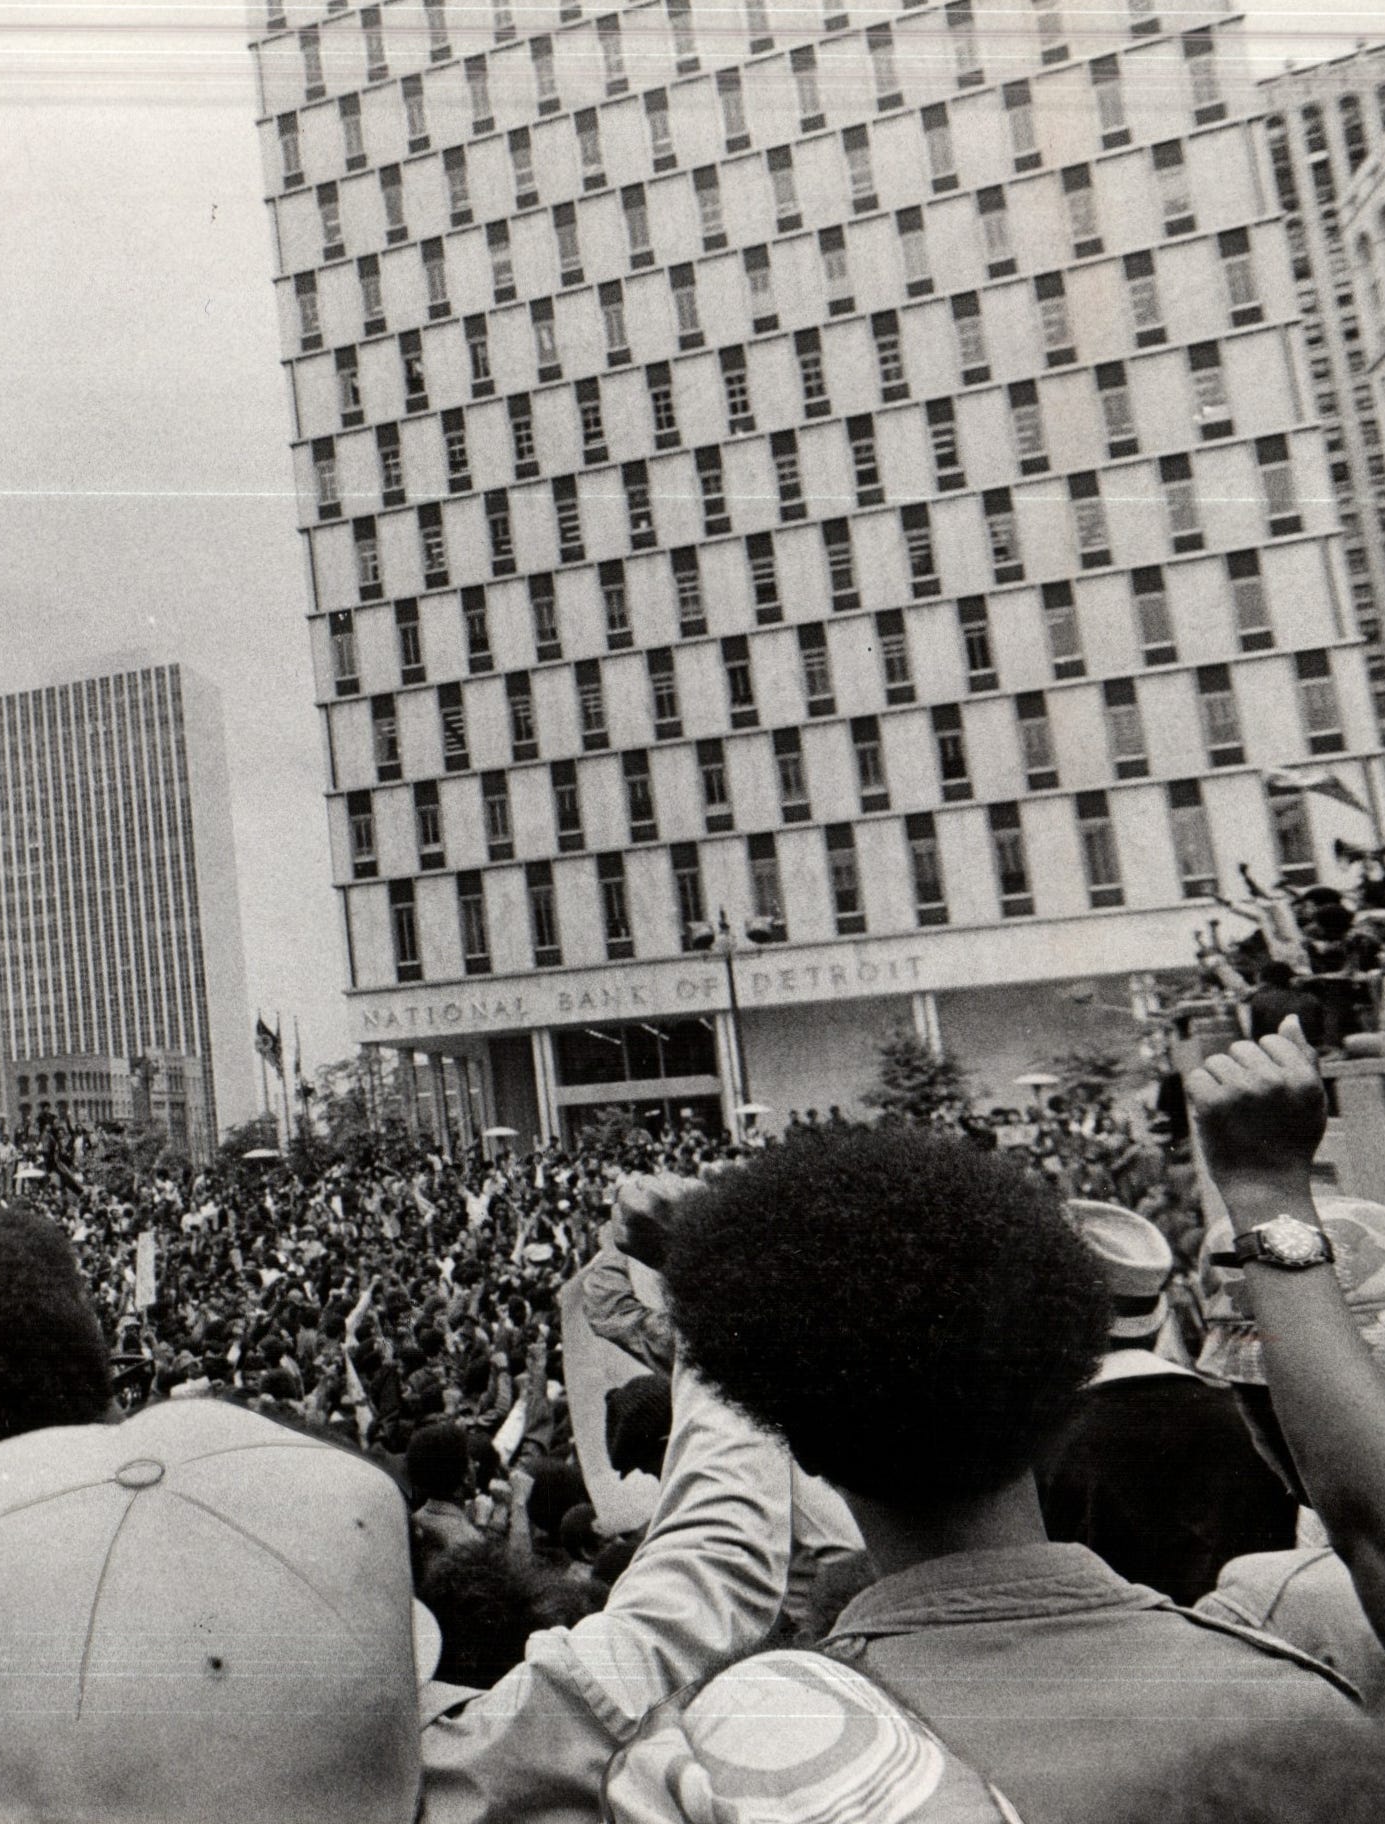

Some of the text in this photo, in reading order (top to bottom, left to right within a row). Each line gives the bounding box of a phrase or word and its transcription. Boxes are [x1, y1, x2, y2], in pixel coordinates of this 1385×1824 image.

[364, 956, 925, 1030] NATIONAL BANK OF DETROIT
